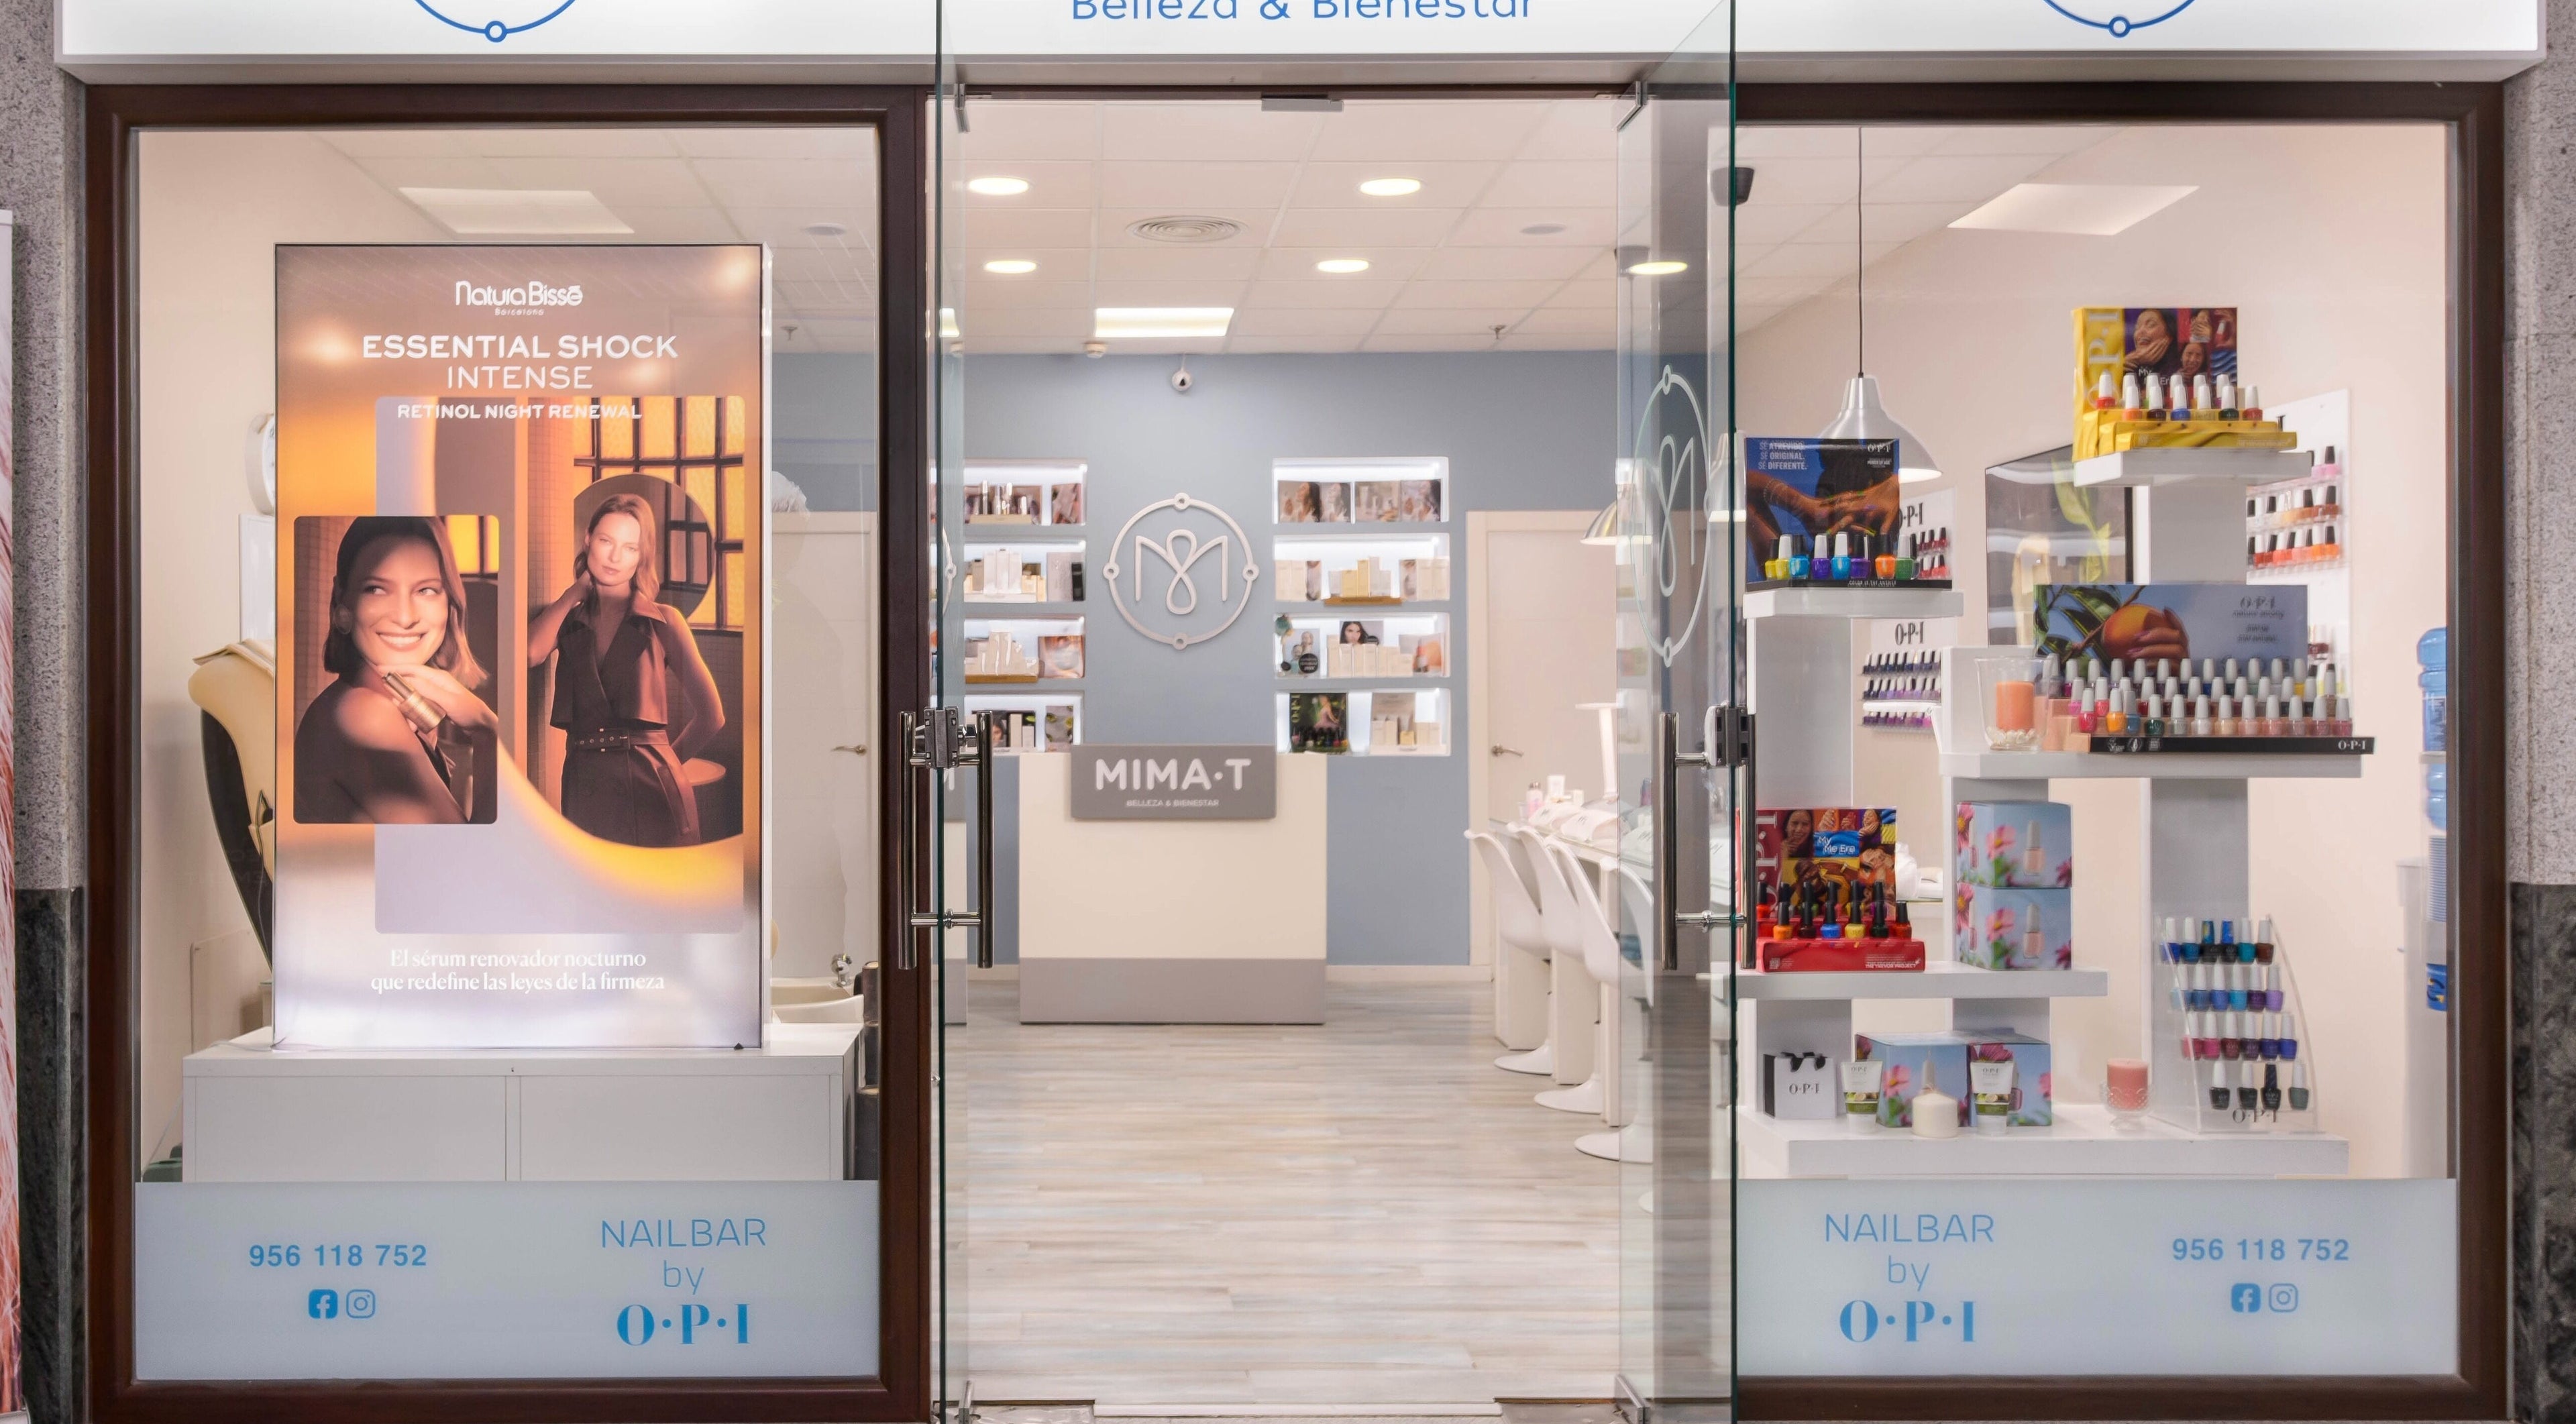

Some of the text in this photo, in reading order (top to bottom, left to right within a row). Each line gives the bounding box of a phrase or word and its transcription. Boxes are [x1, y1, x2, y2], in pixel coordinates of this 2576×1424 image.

[1259, 0, 1291, 20] &
[455, 280, 527, 307] Natura
[363, 335, 678, 359] ESSENTIAL SHOCK
[447, 366, 593, 390] INTENSE
[397, 404, 642, 420] RETINOL NIGHT RENEWAL
[2337, 739, 2365, 751] O·P·I
[1126, 799, 1164, 807] BELLEZA
[1173, 799, 1220, 807] BIENESTAR
[391, 949, 647, 967] El sérum renovador nocturno
[371, 971, 665, 995] que redefine las leyes de la firmeza
[1788, 1083, 1819, 1095] O·P·I
[601, 1218, 766, 1248] NAILBAR
[1825, 1213, 1994, 1243] NAILBAR
[249, 1244, 427, 1267] 956 118 752
[2172, 1238, 2349, 1261] 956 118 752
[663, 1260, 705, 1295] by
[1887, 1255, 1931, 1292] by
[616, 1303, 751, 1346] O·P·I
[1839, 1300, 1976, 1342] O·P·I
